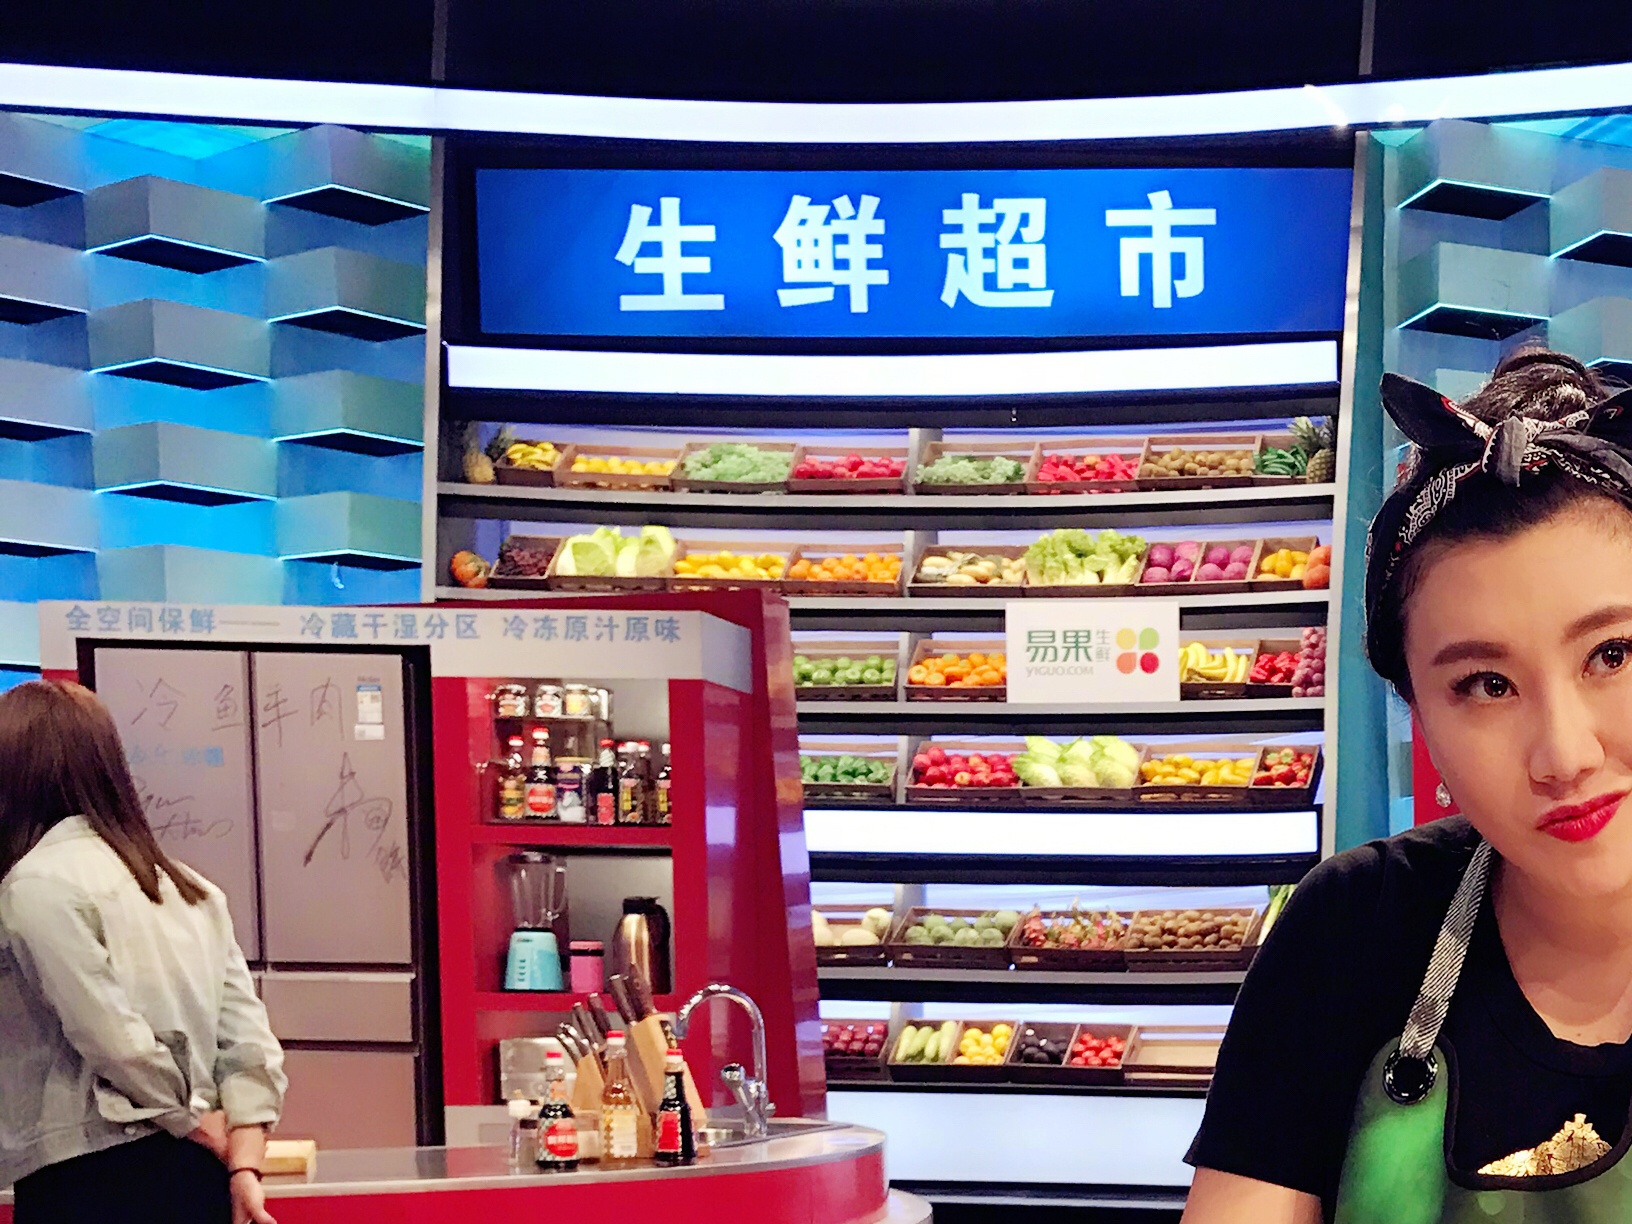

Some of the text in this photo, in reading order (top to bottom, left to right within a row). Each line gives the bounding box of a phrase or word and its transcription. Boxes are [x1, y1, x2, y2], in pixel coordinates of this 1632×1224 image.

[615, 190, 1216, 313] 生鲜超市
[502, 615, 682, 644] 冷冻原汁原味
[1026, 629, 1093, 663] 易果
